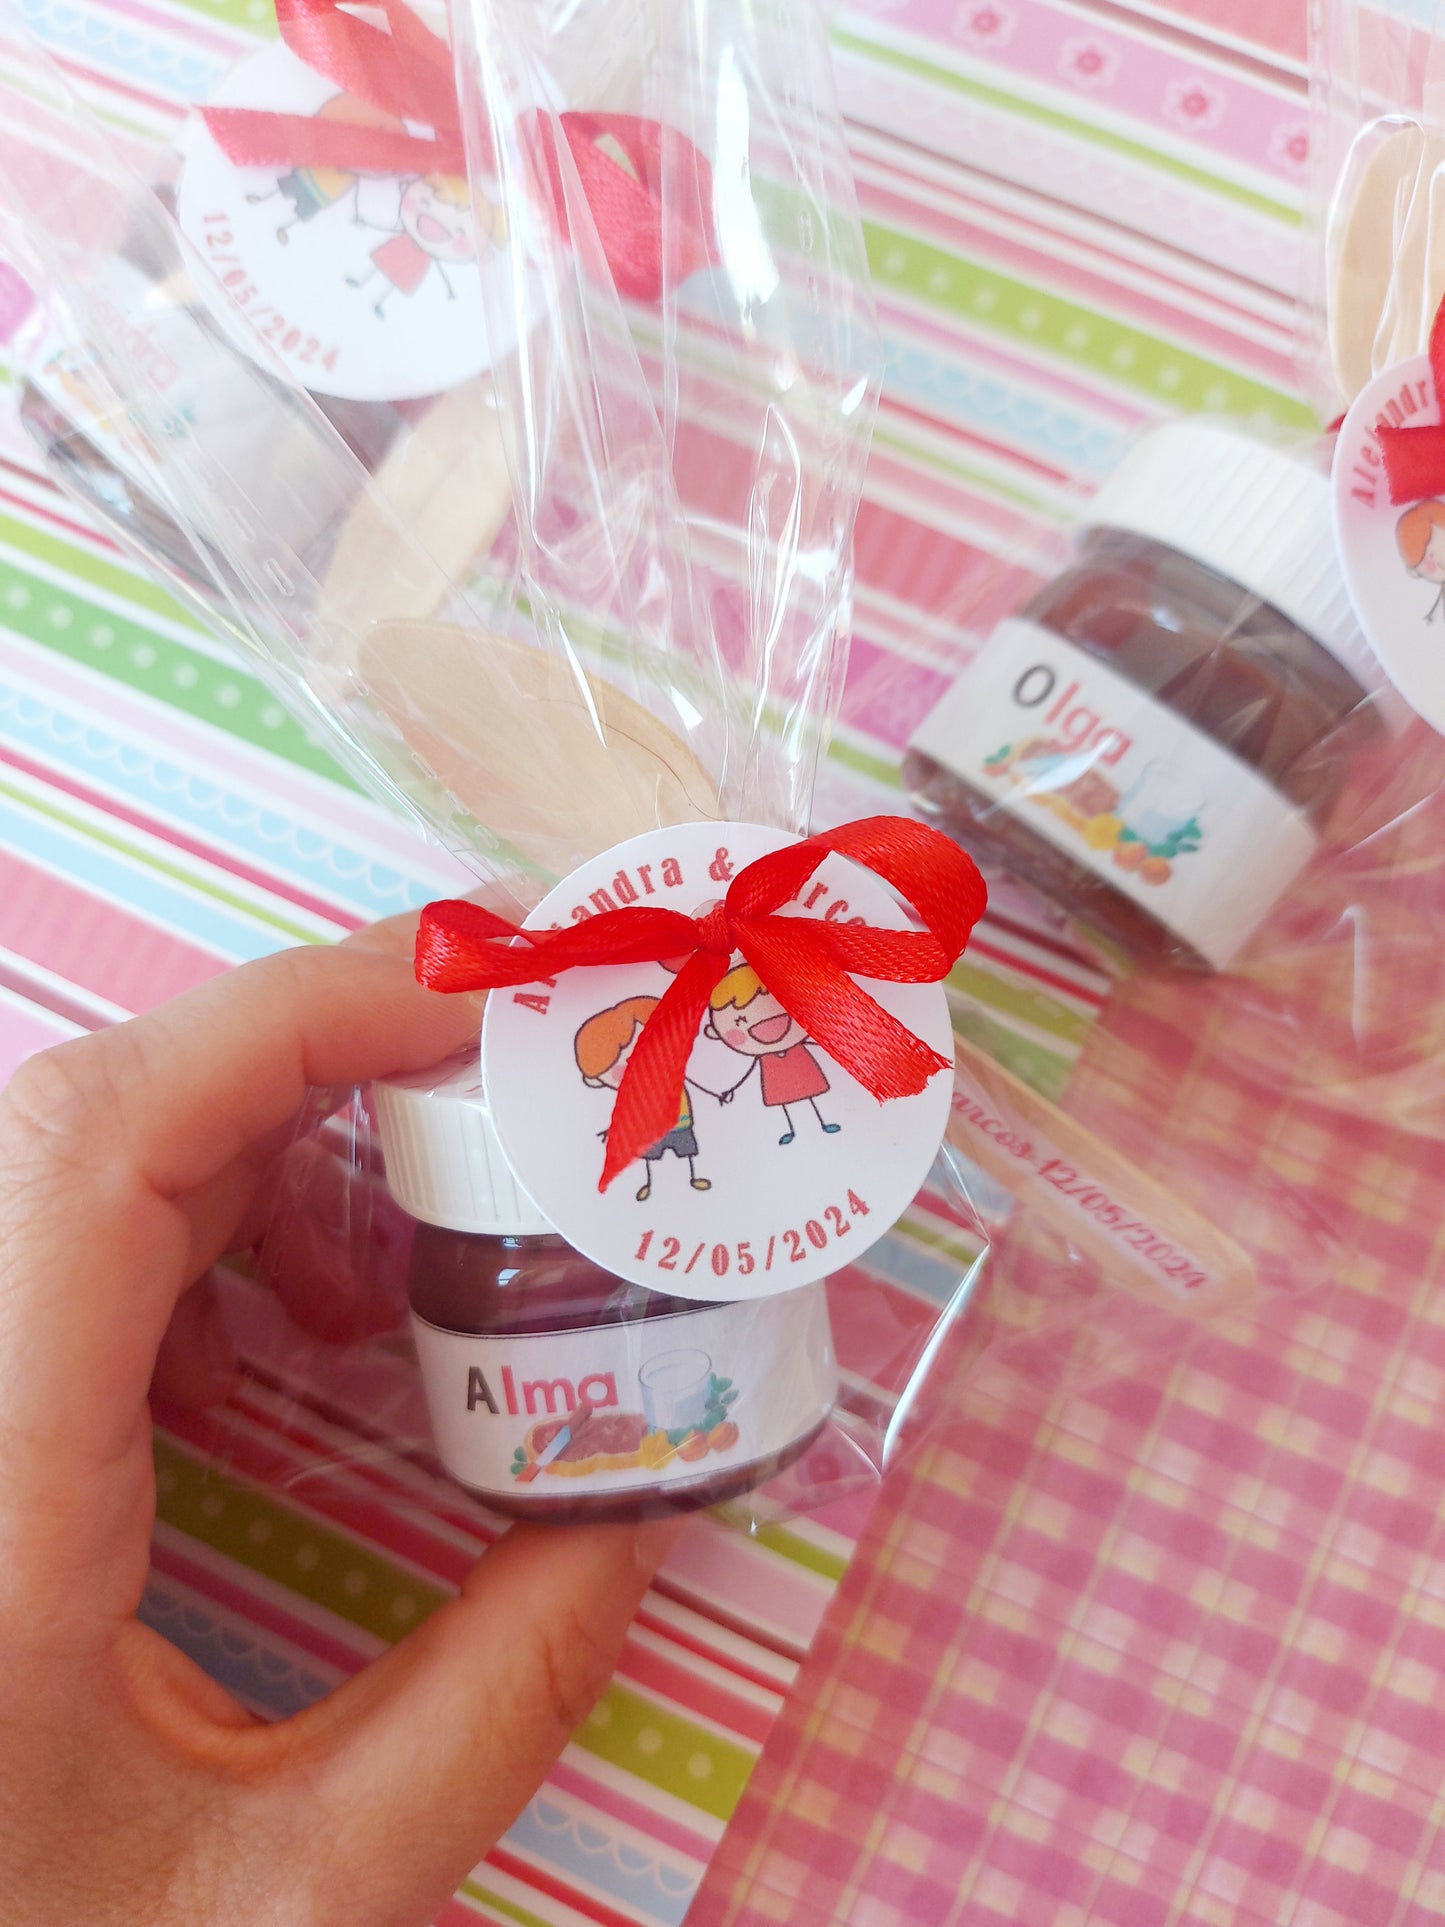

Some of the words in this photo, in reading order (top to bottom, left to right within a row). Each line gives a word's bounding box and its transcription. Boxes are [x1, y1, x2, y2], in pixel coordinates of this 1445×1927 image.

[203, 212, 340, 372] 12/05/2024
[1013, 664, 1132, 768] Olga
[708, 847, 735, 882] &
[634, 1188, 871, 1276] 12/05/2024
[1037, 1158, 1207, 1289] 12/05/2024
[466, 1365, 619, 1415] Alma
